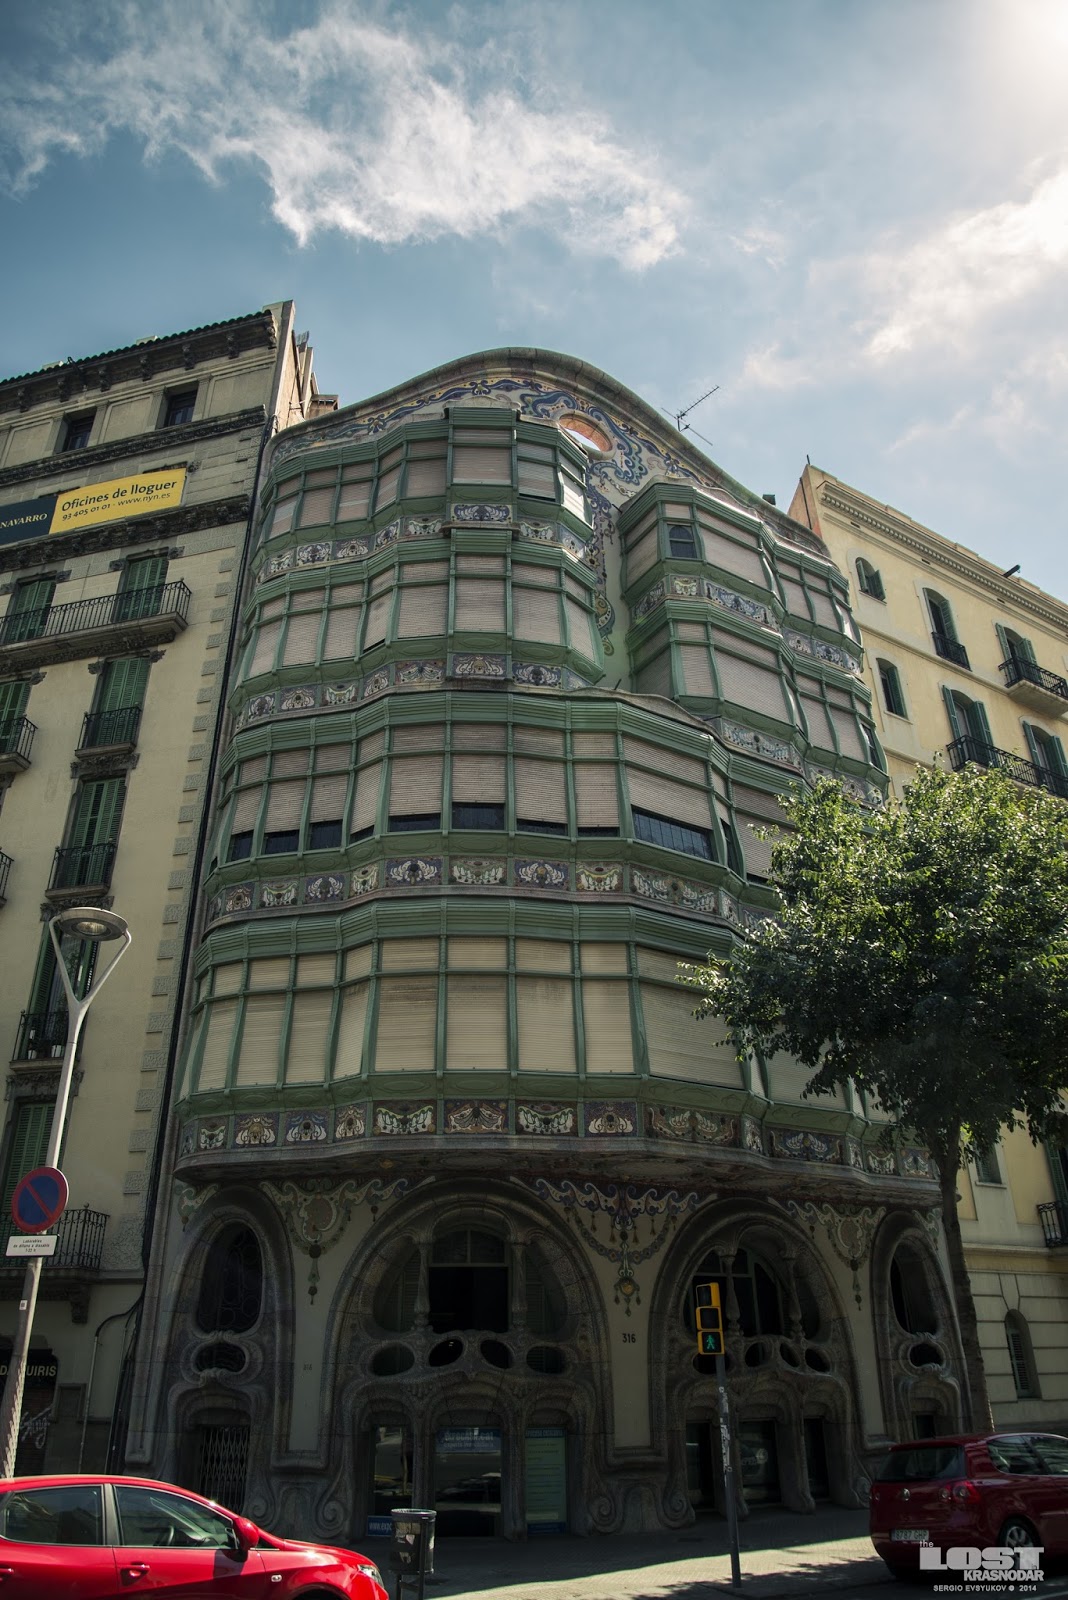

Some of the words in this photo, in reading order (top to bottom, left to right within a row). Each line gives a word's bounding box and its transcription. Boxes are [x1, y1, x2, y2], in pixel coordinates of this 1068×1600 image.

[62, 496, 109, 512] Oficines
[112, 488, 127, 499] de
[130, 481, 177, 495] lloguer
[73, 508, 88, 517] 405
[117, 492, 171, 506] www.nyn.es
[0, 513, 48, 529] NAVARRO
[622, 1333, 636, 1343] 316
[0, 1365, 56, 1376] DUIRIS
